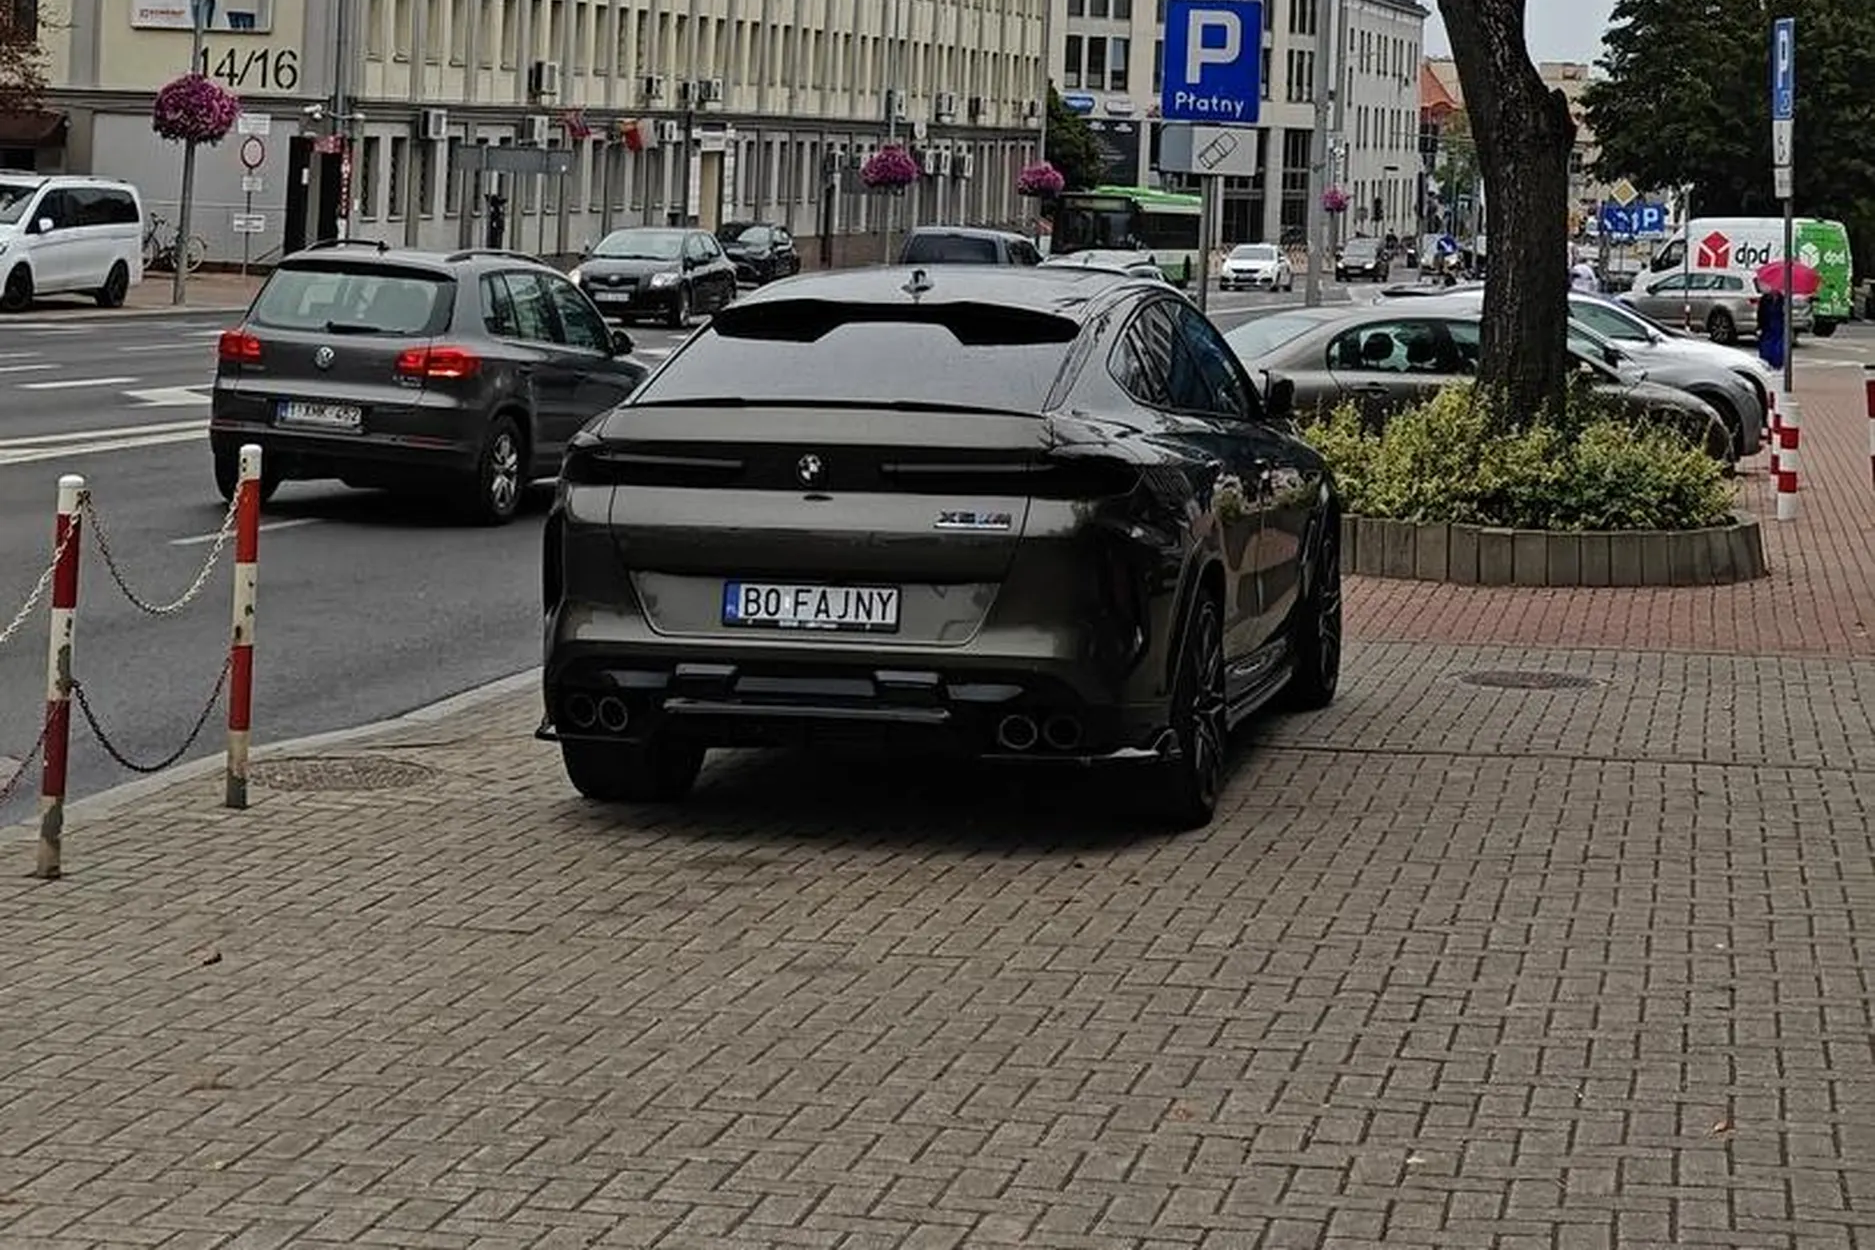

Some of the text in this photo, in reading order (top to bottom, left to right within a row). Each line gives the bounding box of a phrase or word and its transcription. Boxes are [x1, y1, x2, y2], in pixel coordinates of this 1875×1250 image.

[1185, 9, 1241, 84] P
[1778, 30, 1789, 89] P
[200, 47, 298, 90] 14/16
[1175, 91, 1244, 117] Płatny
[1643, 208, 1658, 227] P
[1735, 242, 1771, 268] dpd
[1823, 250, 1846, 266] dpd
[793, 588, 894, 621] FAJNY
